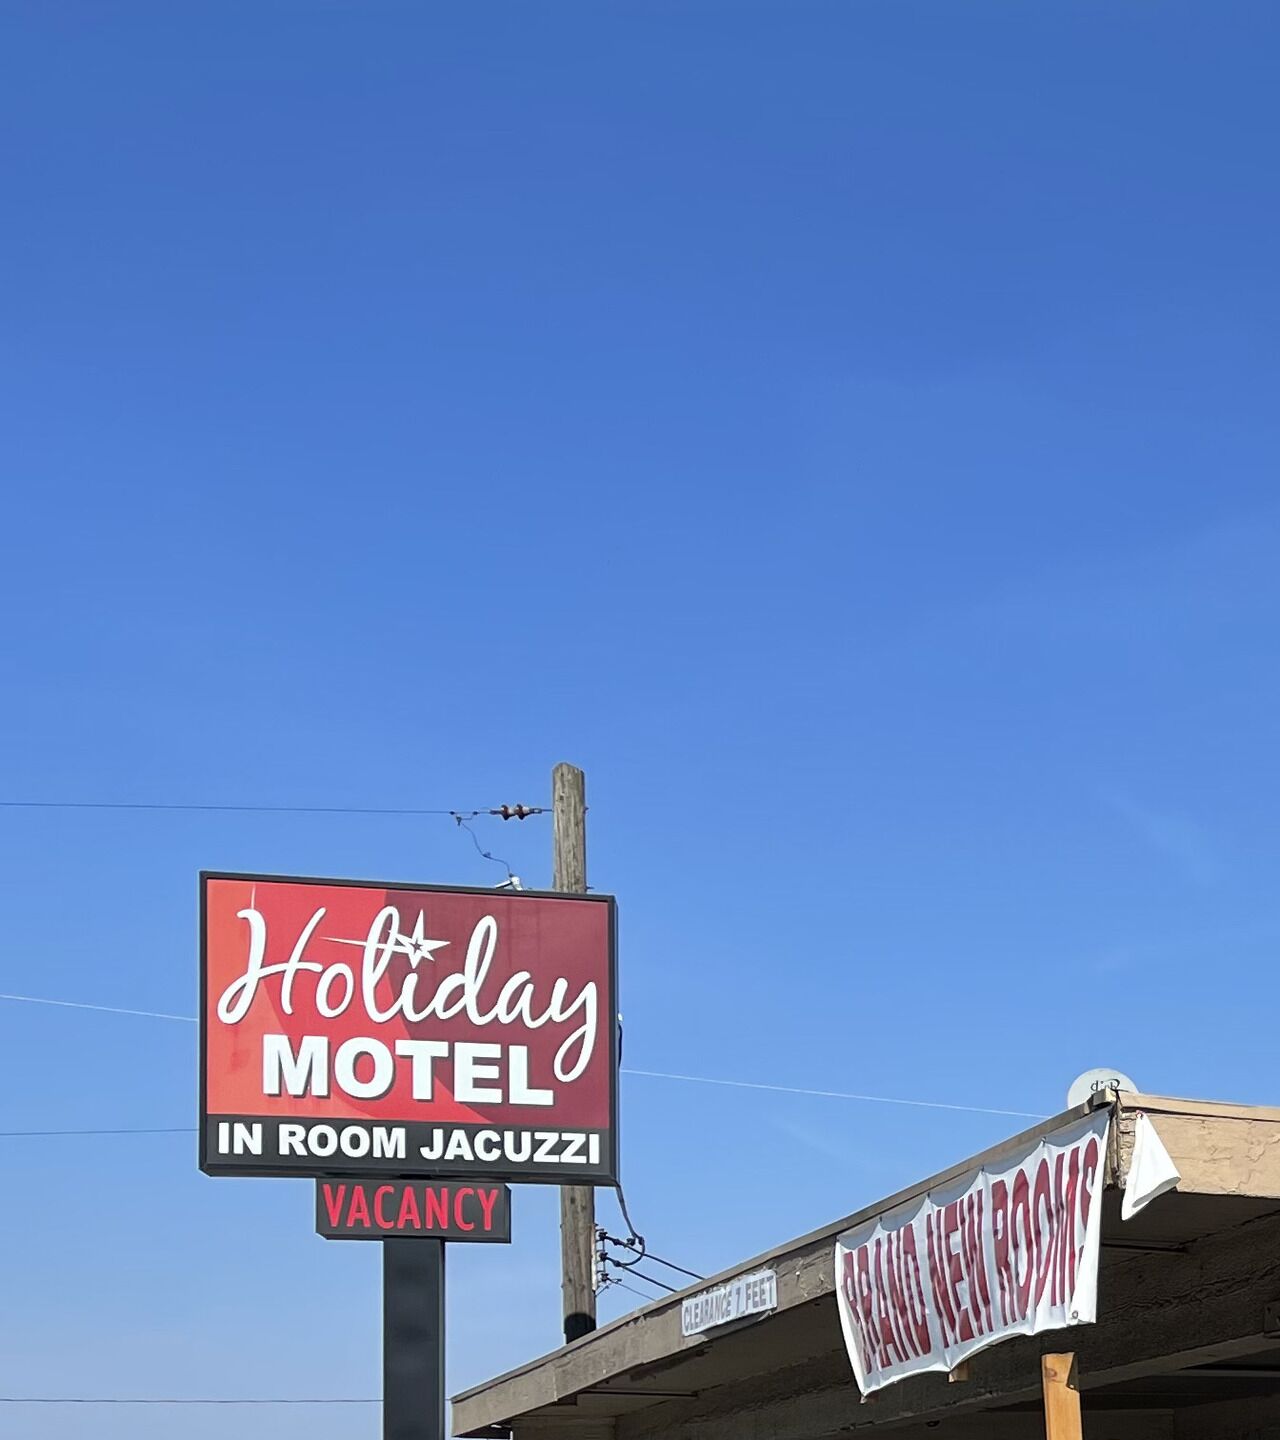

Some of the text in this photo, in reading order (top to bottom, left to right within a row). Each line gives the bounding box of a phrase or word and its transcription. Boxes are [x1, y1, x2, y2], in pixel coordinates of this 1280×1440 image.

[216, 904, 598, 1083] Holiday
[262, 1033, 554, 1106] MOTEL
[217, 1121, 600, 1165] IN ROOM JACUZZI
[322, 1183, 500, 1231] VACANCY
[842, 1137, 1099, 1375] BRAND NEW ROOMS
[683, 1288, 733, 1333] CLEARANCE
[745, 1275, 775, 1312] FEET
